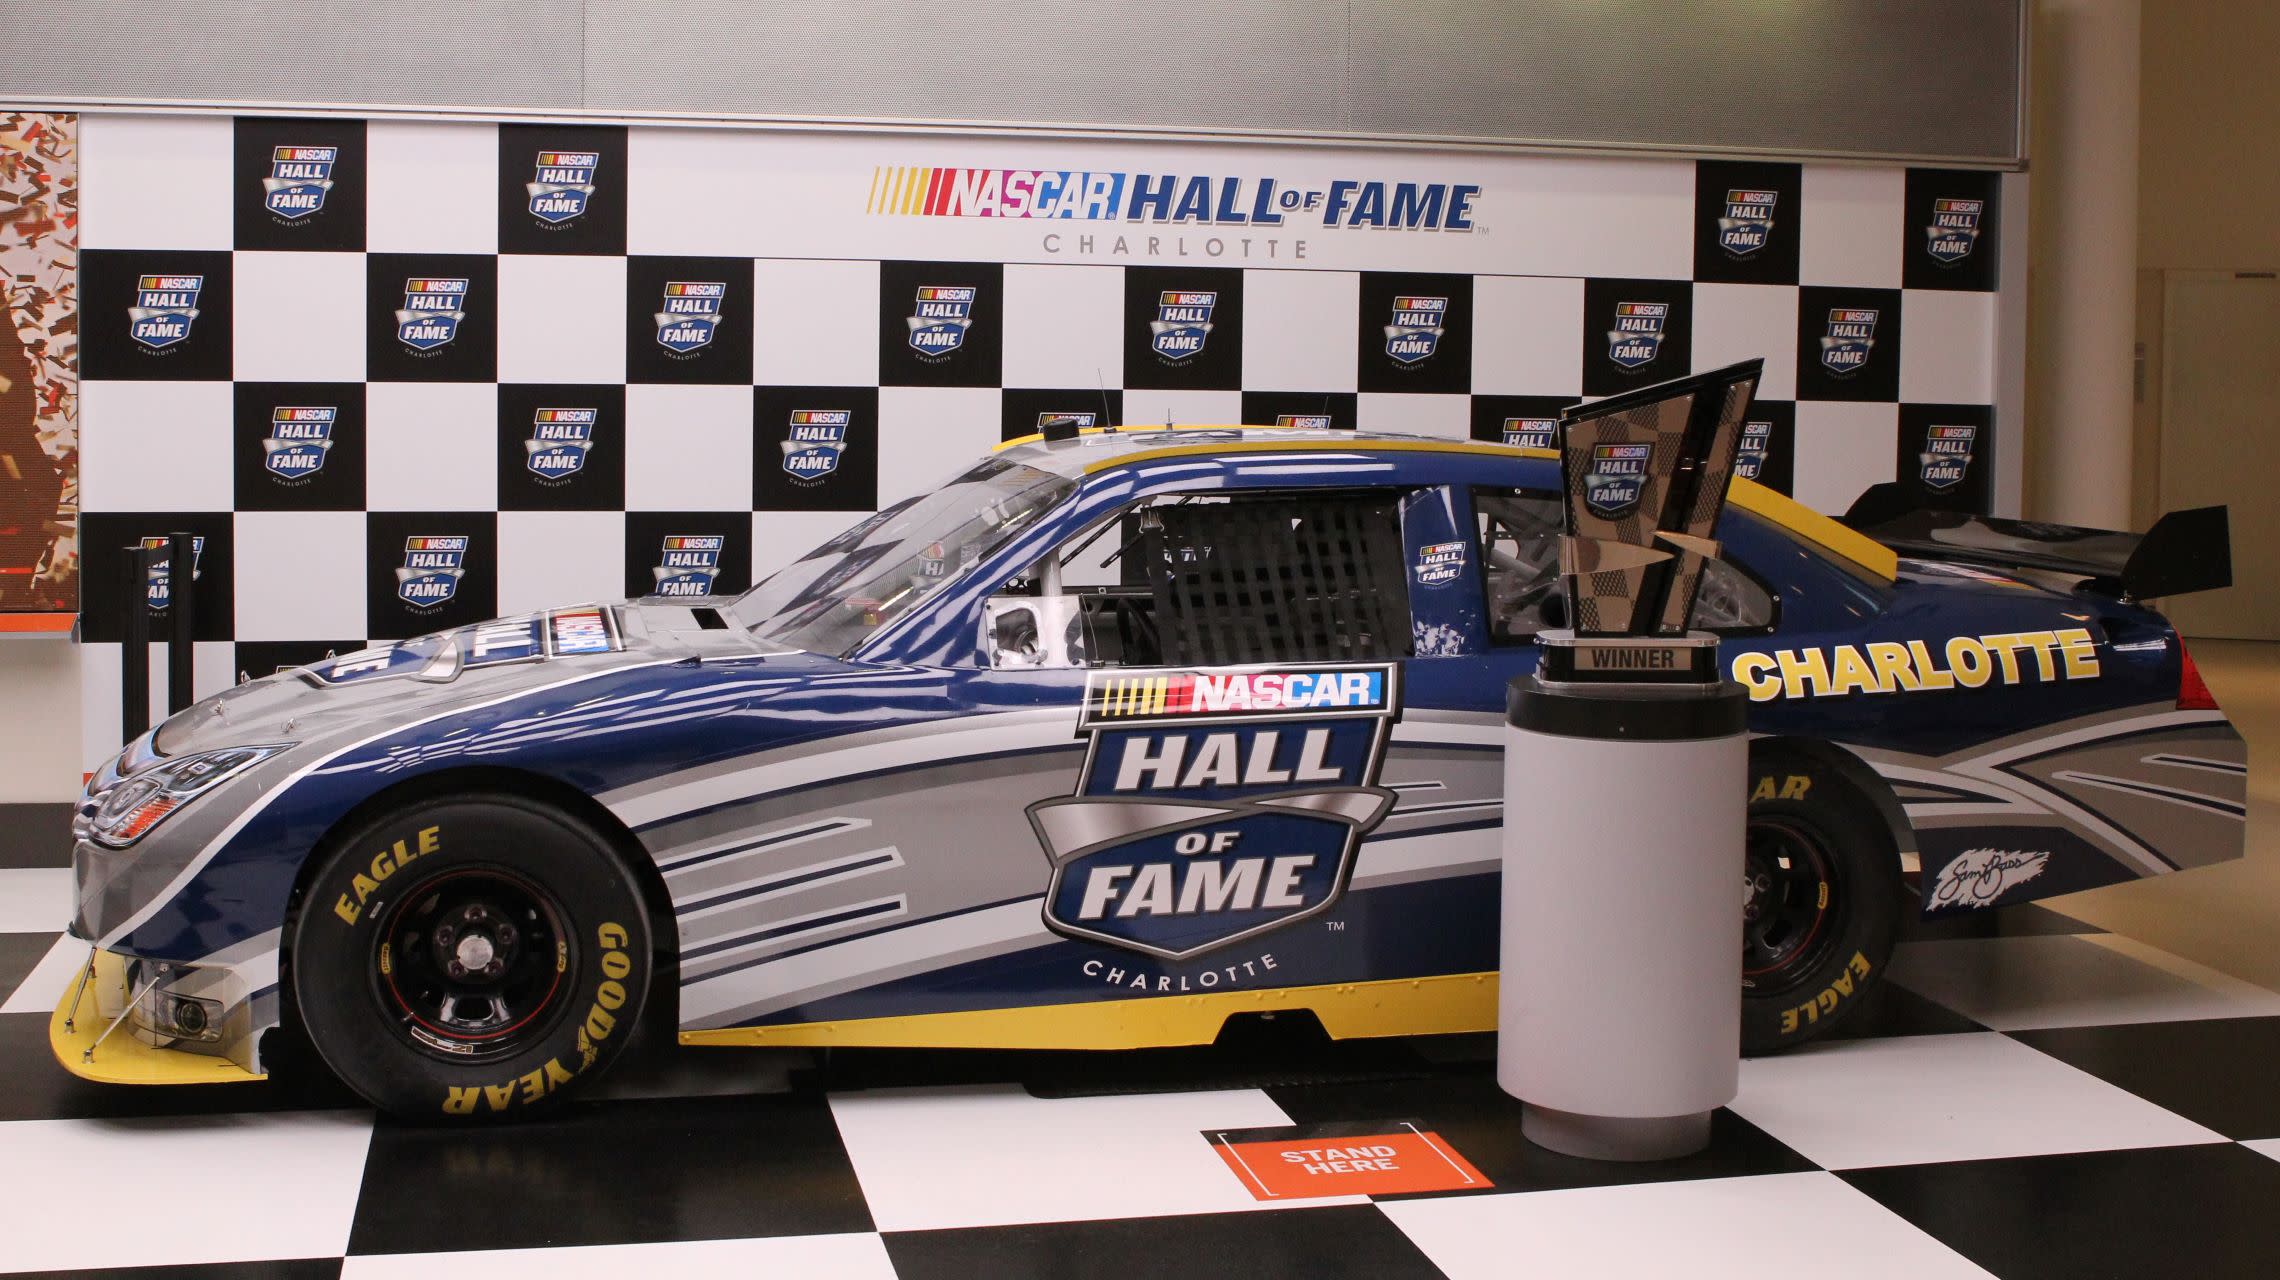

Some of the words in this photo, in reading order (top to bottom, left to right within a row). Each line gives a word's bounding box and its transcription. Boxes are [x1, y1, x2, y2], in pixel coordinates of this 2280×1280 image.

[295, 149, 331, 160] NASCAR
[558, 155, 593, 165] NASCAR
[279, 164, 323, 178] HALL
[542, 169, 585, 183] HALL
[272, 194, 318, 208] FAME
[946, 168, 1114, 219] NASCAR
[1127, 175, 1284, 226] HALL
[1279, 190, 1323, 211] OF
[1323, 180, 1480, 232] FAME
[1744, 193, 1773, 203] NASCAR
[535, 199, 580, 213] FAME
[1731, 206, 1766, 218] HALL
[1951, 202, 1978, 212] NASCAR
[1938, 215, 1972, 227] HALL
[1725, 232, 1762, 245] FAME
[1043, 234, 1306, 259] CHARLOTTE
[1932, 241, 1967, 253] FAME
[161, 278, 197, 289] NASCAR
[427, 281, 462, 292] NASCAR
[686, 285, 720, 295] NASCAR
[937, 289, 970, 300] NASCAR
[145, 293, 189, 306] HALL
[412, 296, 455, 309] HALL
[1179, 294, 1211, 304] NASCAR
[1412, 299, 1442, 309] NASCAR
[670, 299, 712, 312] HALL
[922, 304, 962, 317] HALL
[1634, 305, 1663, 315] NASCAR
[1165, 308, 1204, 321] HALL
[1398, 313, 1435, 326] HALL
[1846, 312, 1873, 321] NASCAR
[137, 324, 184, 337] FAME
[1621, 319, 1656, 331] HALL
[1833, 325, 1867, 337] HALL
[404, 326, 450, 339] FAME
[663, 329, 707, 342] FAME
[915, 333, 958, 346] FAME
[1158, 337, 1199, 350] FAME
[1391, 341, 1431, 354] FAME
[1614, 346, 1652, 358] FAME
[1827, 351, 1863, 364] FAME
[295, 410, 330, 420] NASCAR
[556, 411, 591, 421] NASCAR
[811, 413, 845, 423] NASCAR
[1295, 417, 1326, 428] NASCAR
[1521, 421, 1552, 430] NASCAR
[279, 425, 323, 438] HALL
[541, 426, 583, 439] HALL
[796, 427, 837, 440] HALL
[1944, 428, 1971, 437] NASCAR
[1509, 435, 1545, 447] HALL
[1932, 441, 1965, 453] HALL
[1613, 448, 1645, 457] NASCAR
[272, 455, 318, 468] FAME
[533, 456, 578, 469] FAME
[789, 457, 832, 469] FAME
[1599, 461, 1638, 473] HALL
[1734, 465, 1756, 476] ME
[1925, 467, 1961, 479] FAME
[1592, 489, 1634, 501] FAME
[427, 539, 462, 549] NASCAR
[683, 538, 718, 549] NASCAR
[412, 554, 455, 567] HALL
[668, 553, 711, 566] HALL
[1425, 552, 1458, 564] HALL
[1423, 569, 1456, 581] FAME
[148, 586, 169, 598] AM
[404, 584, 450, 596] FAME
[662, 582, 705, 595] FAME
[1592, 649, 1674, 668] WINNER
[1732, 628, 2100, 701] CHARLOTTE
[1191, 673, 1370, 712] NASCAR
[1114, 728, 1342, 791] HALL
[1175, 831, 1240, 855] OF
[334, 826, 440, 926] EAGLE
[1078, 855, 1317, 920] FAME
[1326, 922, 1345, 931] TM
[1082, 953, 1279, 992] CHARLOTTE
[1780, 950, 1872, 1034] EAGLE
[1280, 1145, 1397, 1163] STAND
[1304, 1158, 1400, 1175] HERE
